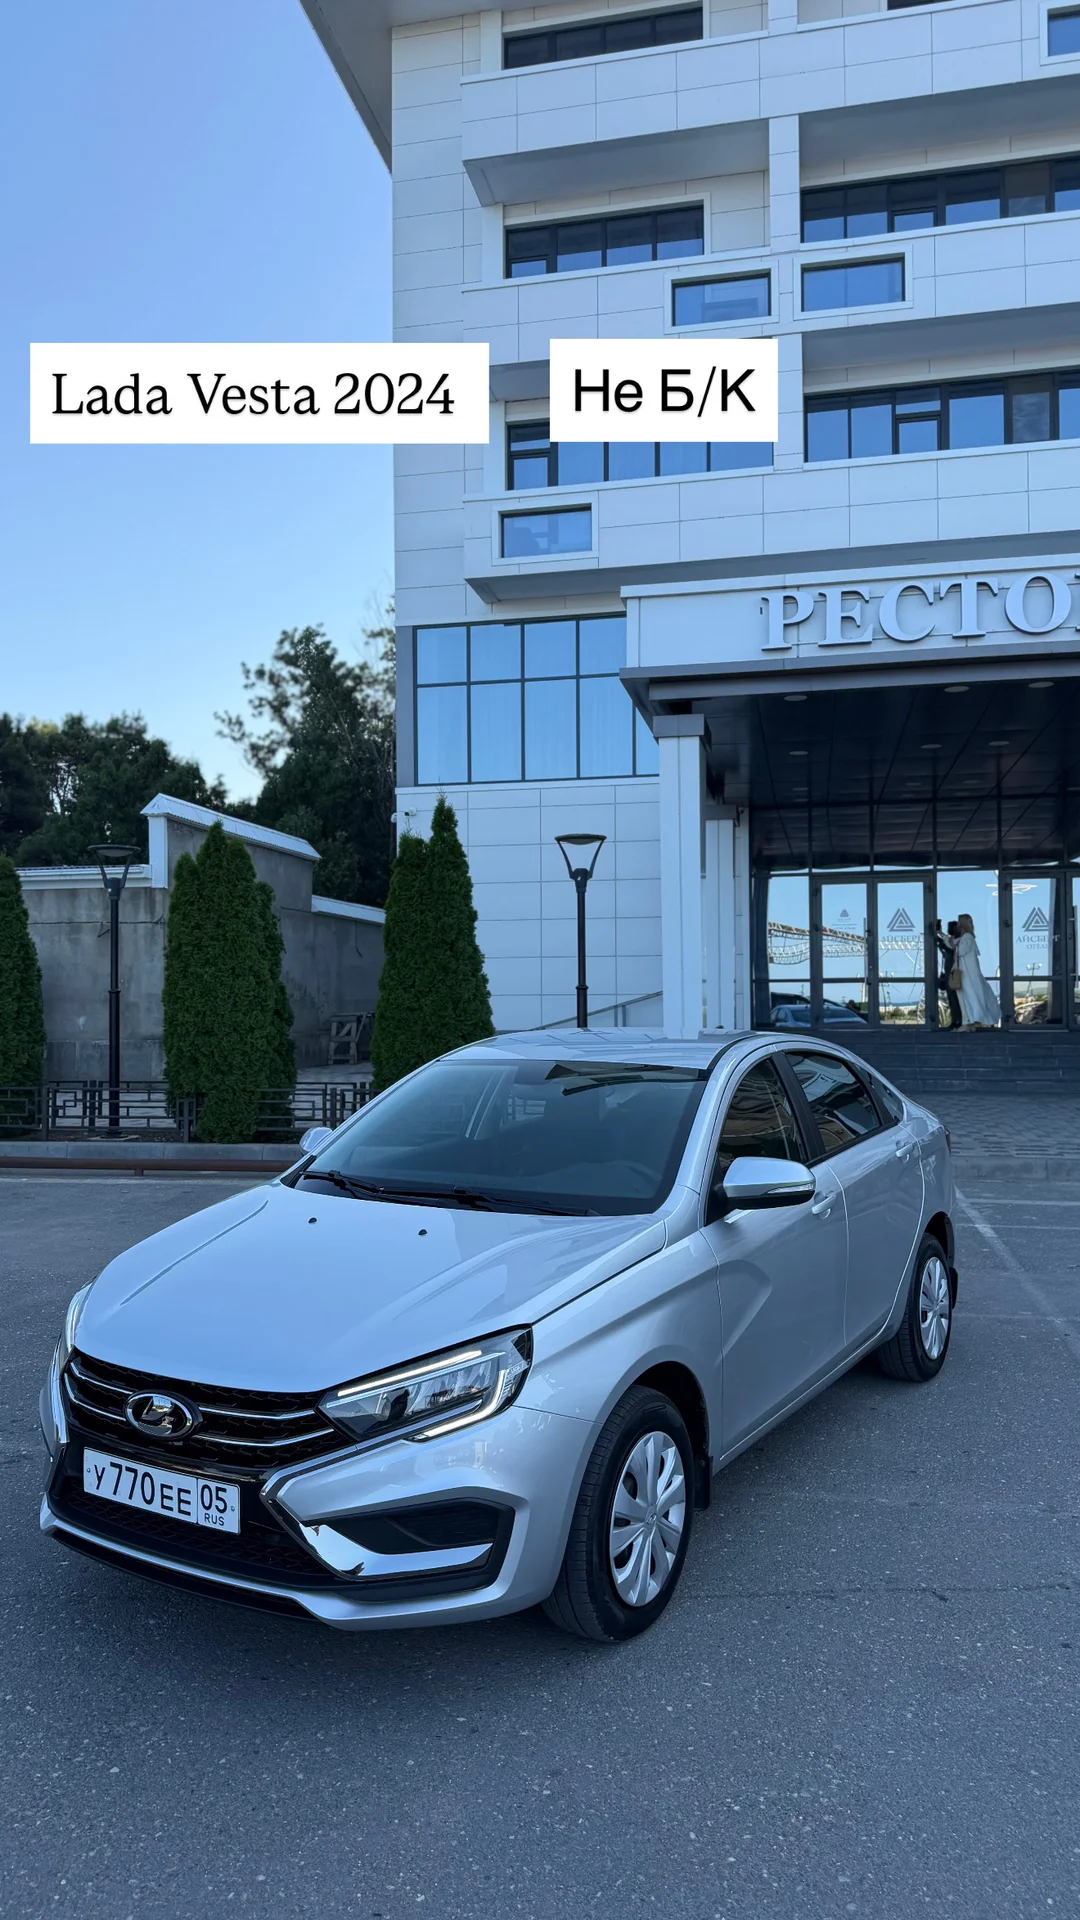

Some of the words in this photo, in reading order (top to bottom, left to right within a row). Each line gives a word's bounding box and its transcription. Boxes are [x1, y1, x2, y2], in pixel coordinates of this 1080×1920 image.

[760, 573, 1080, 651] РЕСТО
[94, 1462, 191, 1516] У770ЕЕ
[201, 1484, 228, 1514] 05
[204, 1512, 225, 1527] RUS
